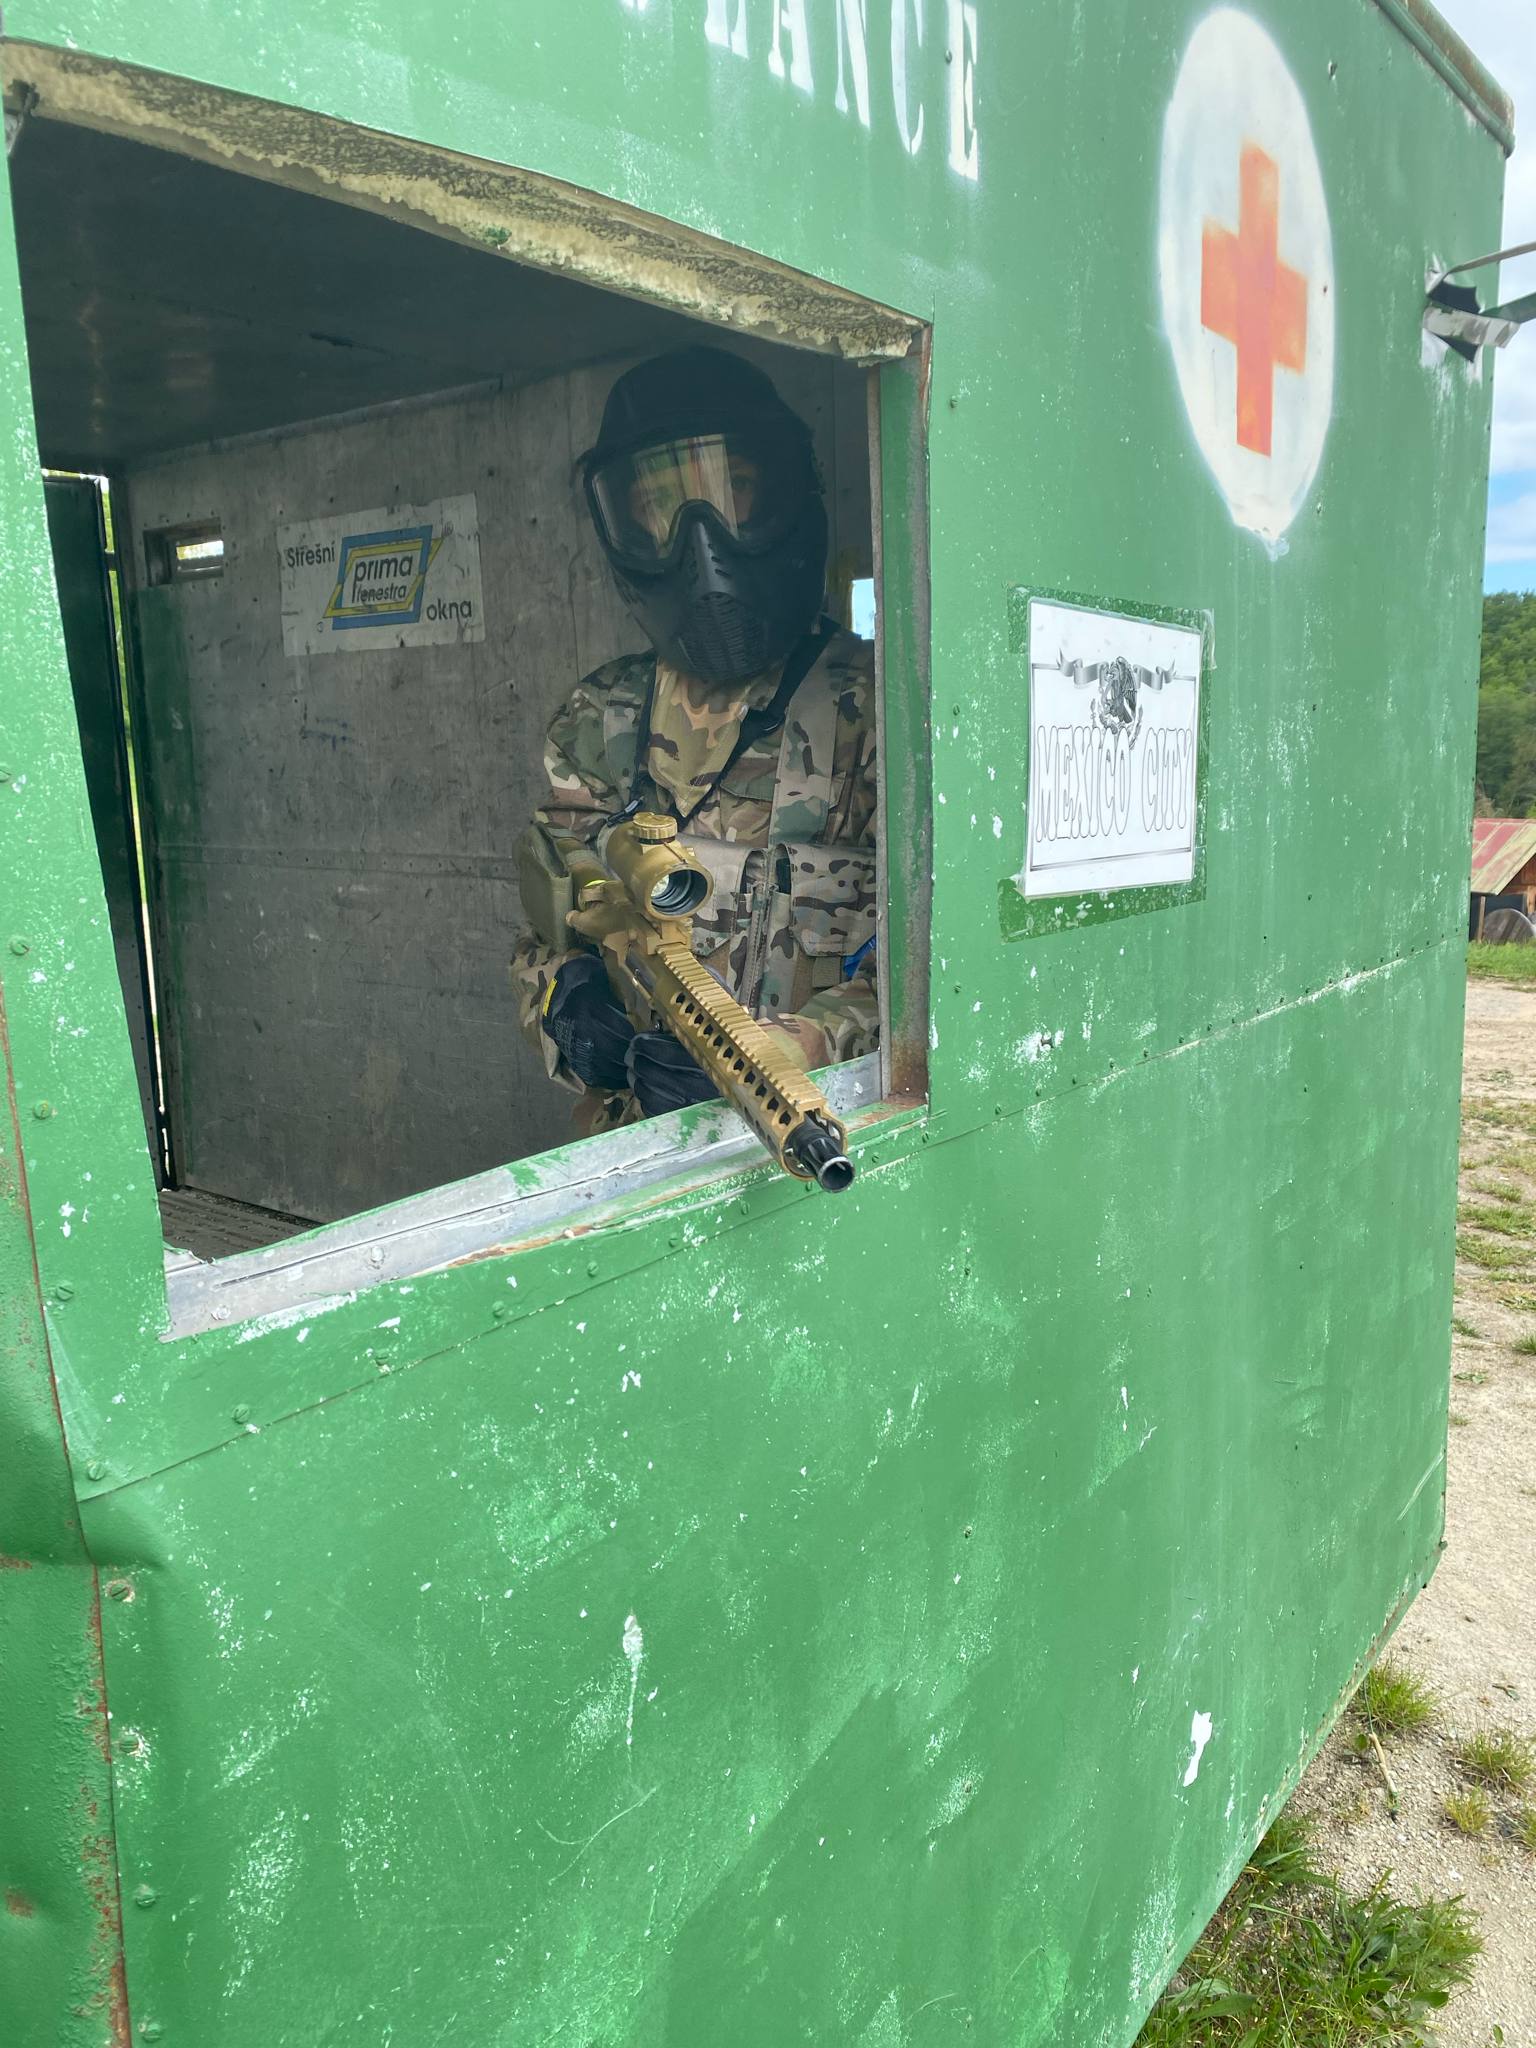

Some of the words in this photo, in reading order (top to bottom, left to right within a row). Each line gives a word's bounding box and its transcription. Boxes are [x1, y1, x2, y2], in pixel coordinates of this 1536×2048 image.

[288, 540, 335, 568] Střešní
[352, 556, 413, 604] prima
[357, 582, 407, 602] fenestra
[427, 598, 473, 622] okna
[1036, 725, 1131, 842] MEXICO
[1143, 727, 1192, 832] CITY
